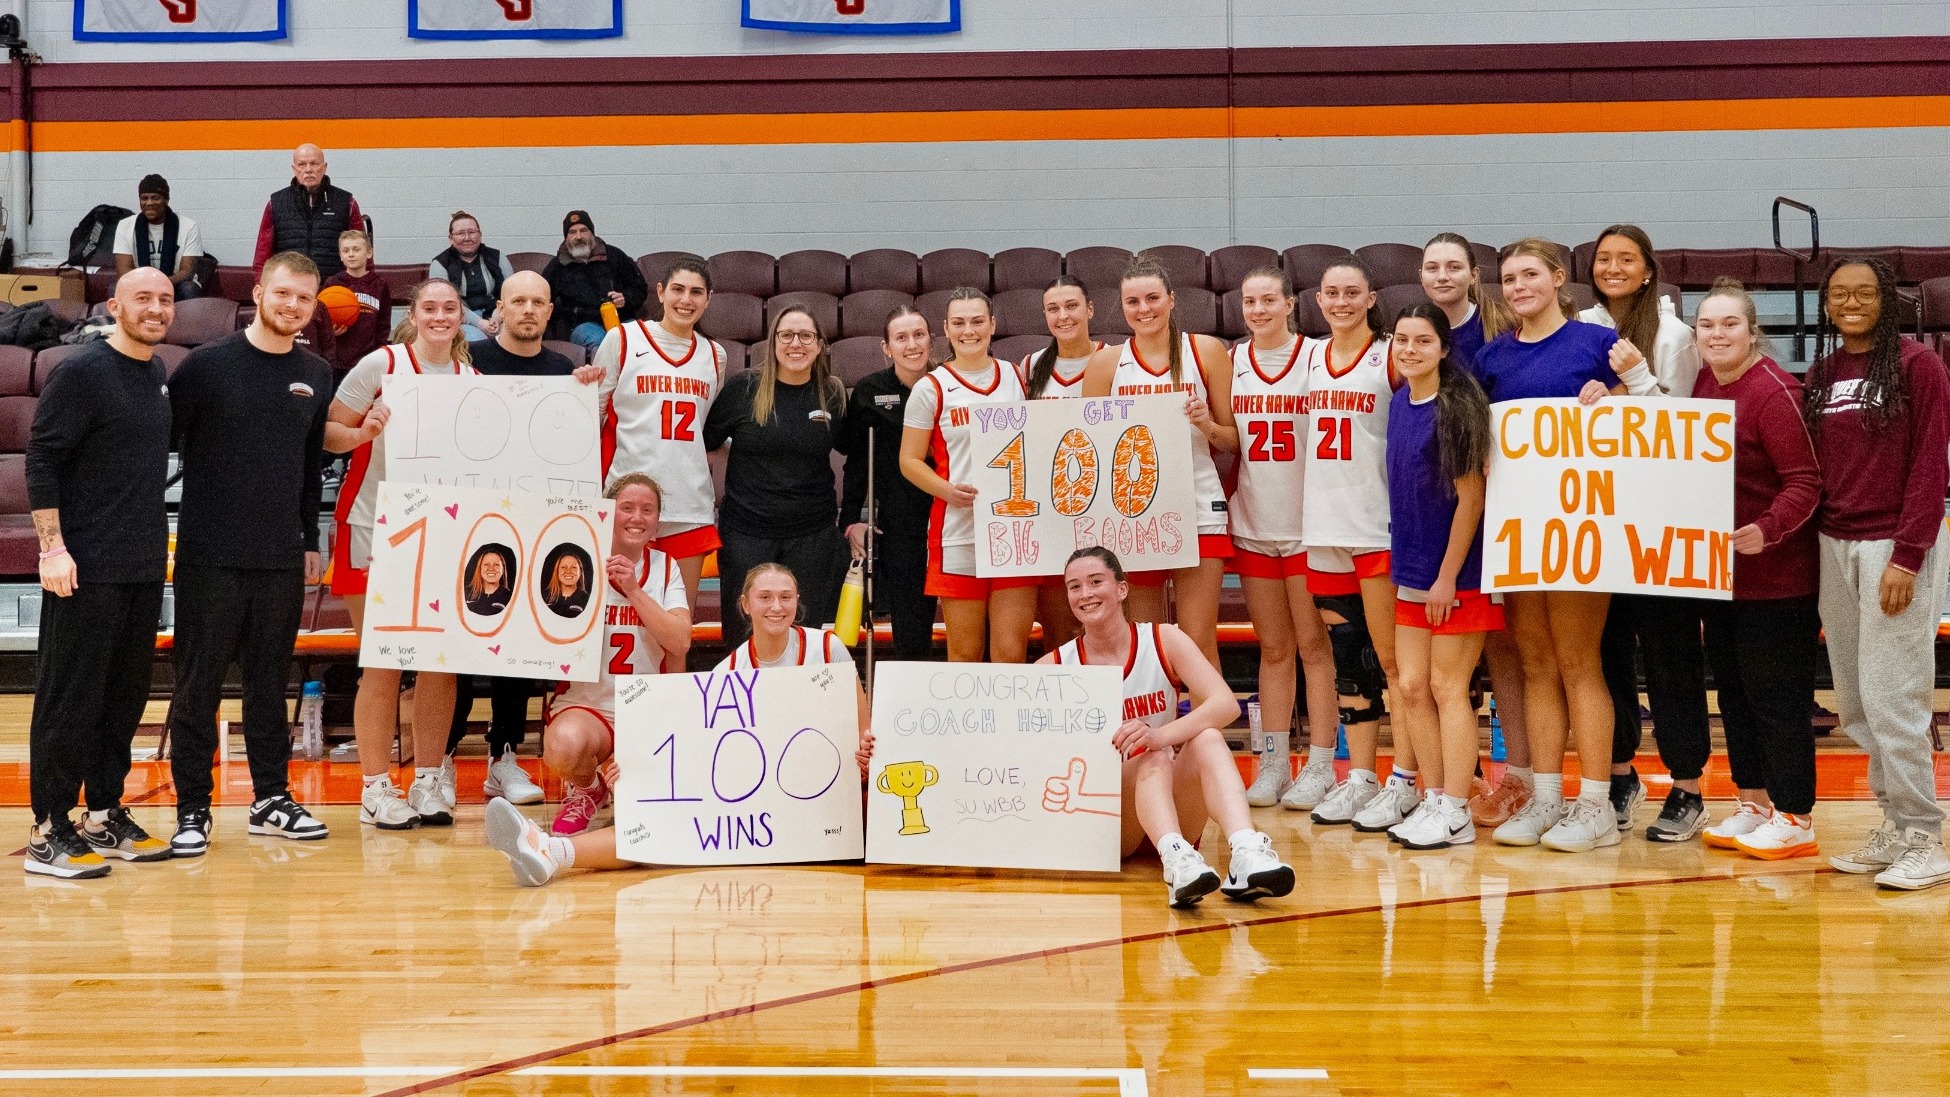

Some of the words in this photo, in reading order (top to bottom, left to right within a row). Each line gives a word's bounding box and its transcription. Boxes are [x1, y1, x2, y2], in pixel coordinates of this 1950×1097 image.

[636, 375, 673, 395] RIVER
[674, 376, 711, 402] HAWKS
[1233, 394, 1264, 415] RIVER
[1330, 390, 1377, 414] HAWKS
[396, 386, 596, 466] 100
[660, 399, 697, 442] 12
[974, 405, 1028, 434] YOU
[1083, 399, 1135, 426] GET
[1500, 405, 1734, 463] CONGRATS
[1247, 420, 1296, 462] 25
[1316, 416, 1353, 461] 21
[986, 424, 1160, 519] 100
[1559, 467, 1616, 517] ON
[987, 520, 1040, 568] BIG
[1073, 511, 1184, 557] BOOMS
[1493, 517, 1602, 589] 100
[373, 512, 604, 646] 100
[378, 645, 393, 656] We
[398, 645, 417, 655] love
[522, 659, 555, 670] amazing!
[608, 632, 636, 675] 2
[693, 669, 760, 729] YAY
[928, 672, 1090, 705] CONGRATS
[1122, 690, 1167, 721] AWKS
[893, 707, 997, 737] COACH
[1017, 706, 1107, 735] HOLKO
[636, 727, 842, 804] 100
[964, 766, 1027, 789] LOVE,
[954, 797, 977, 815] SU
[983, 794, 1027, 815] WBB
[693, 811, 774, 852] WINS
